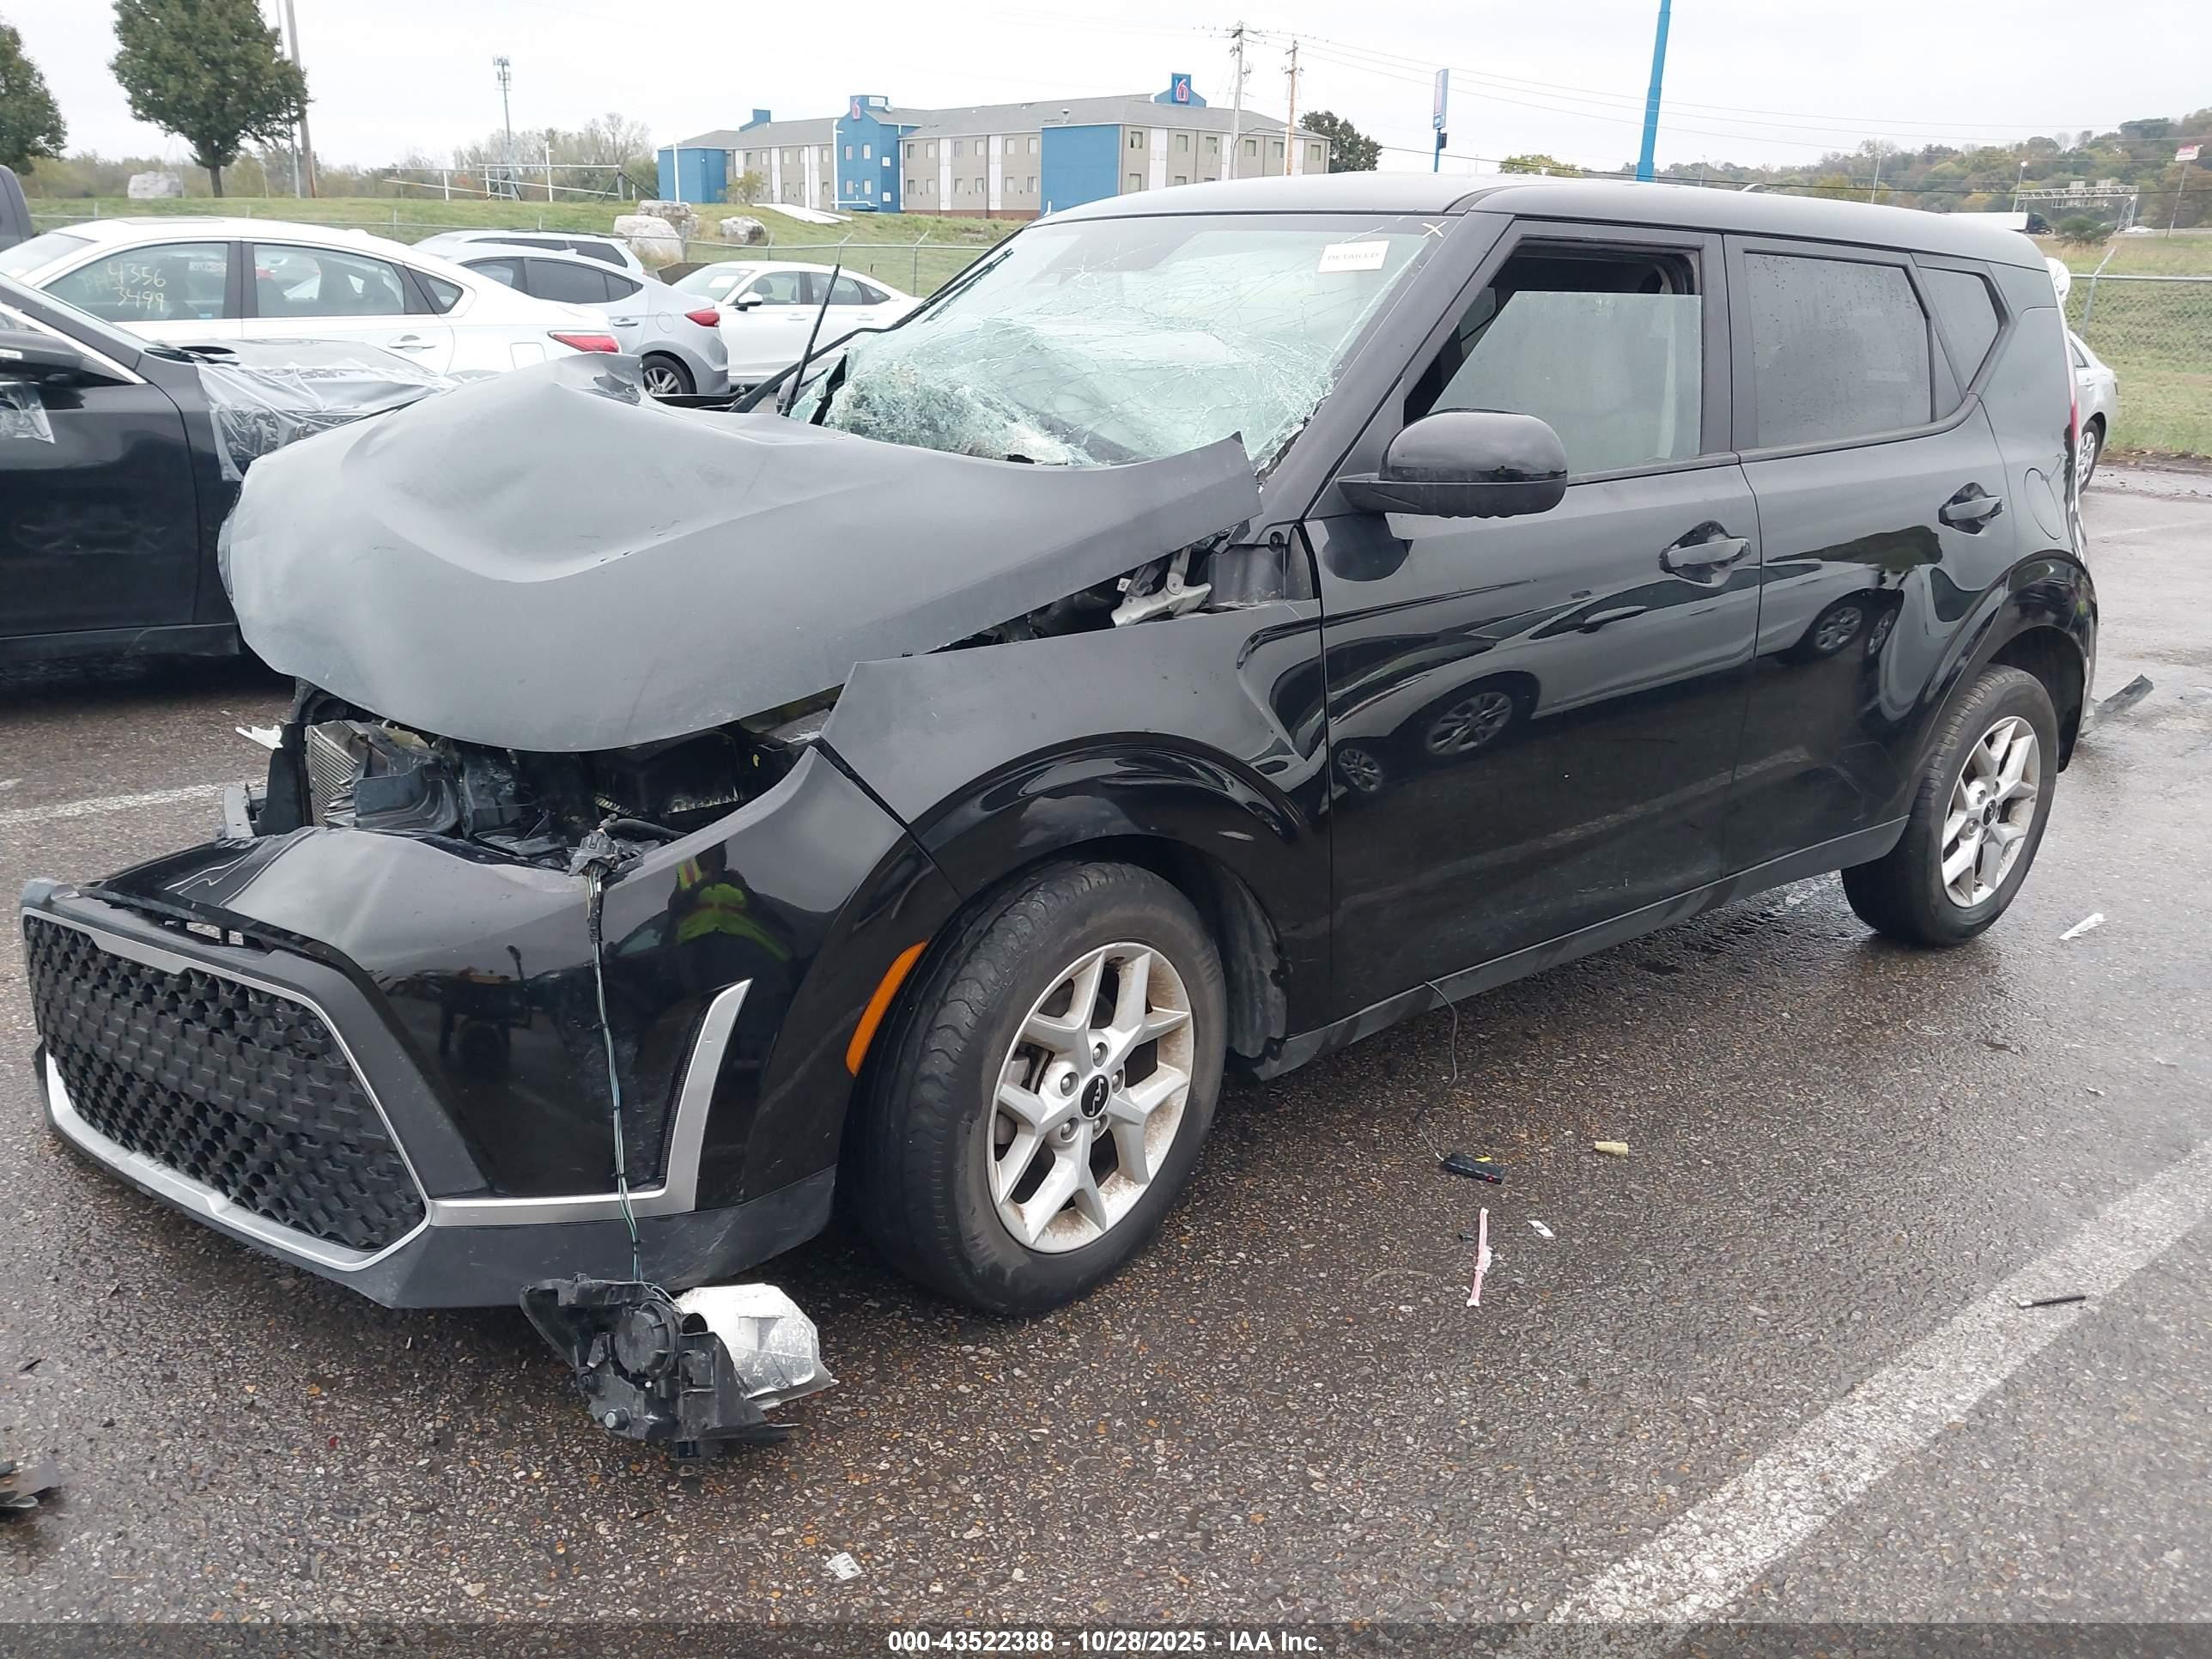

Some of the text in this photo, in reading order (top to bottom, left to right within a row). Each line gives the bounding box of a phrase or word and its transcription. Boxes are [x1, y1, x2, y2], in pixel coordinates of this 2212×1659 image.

[1176, 78, 1189, 102] 6
[851, 98, 860, 119] 6
[107, 261, 167, 288] 4356
[112, 286, 166, 313] 3499
